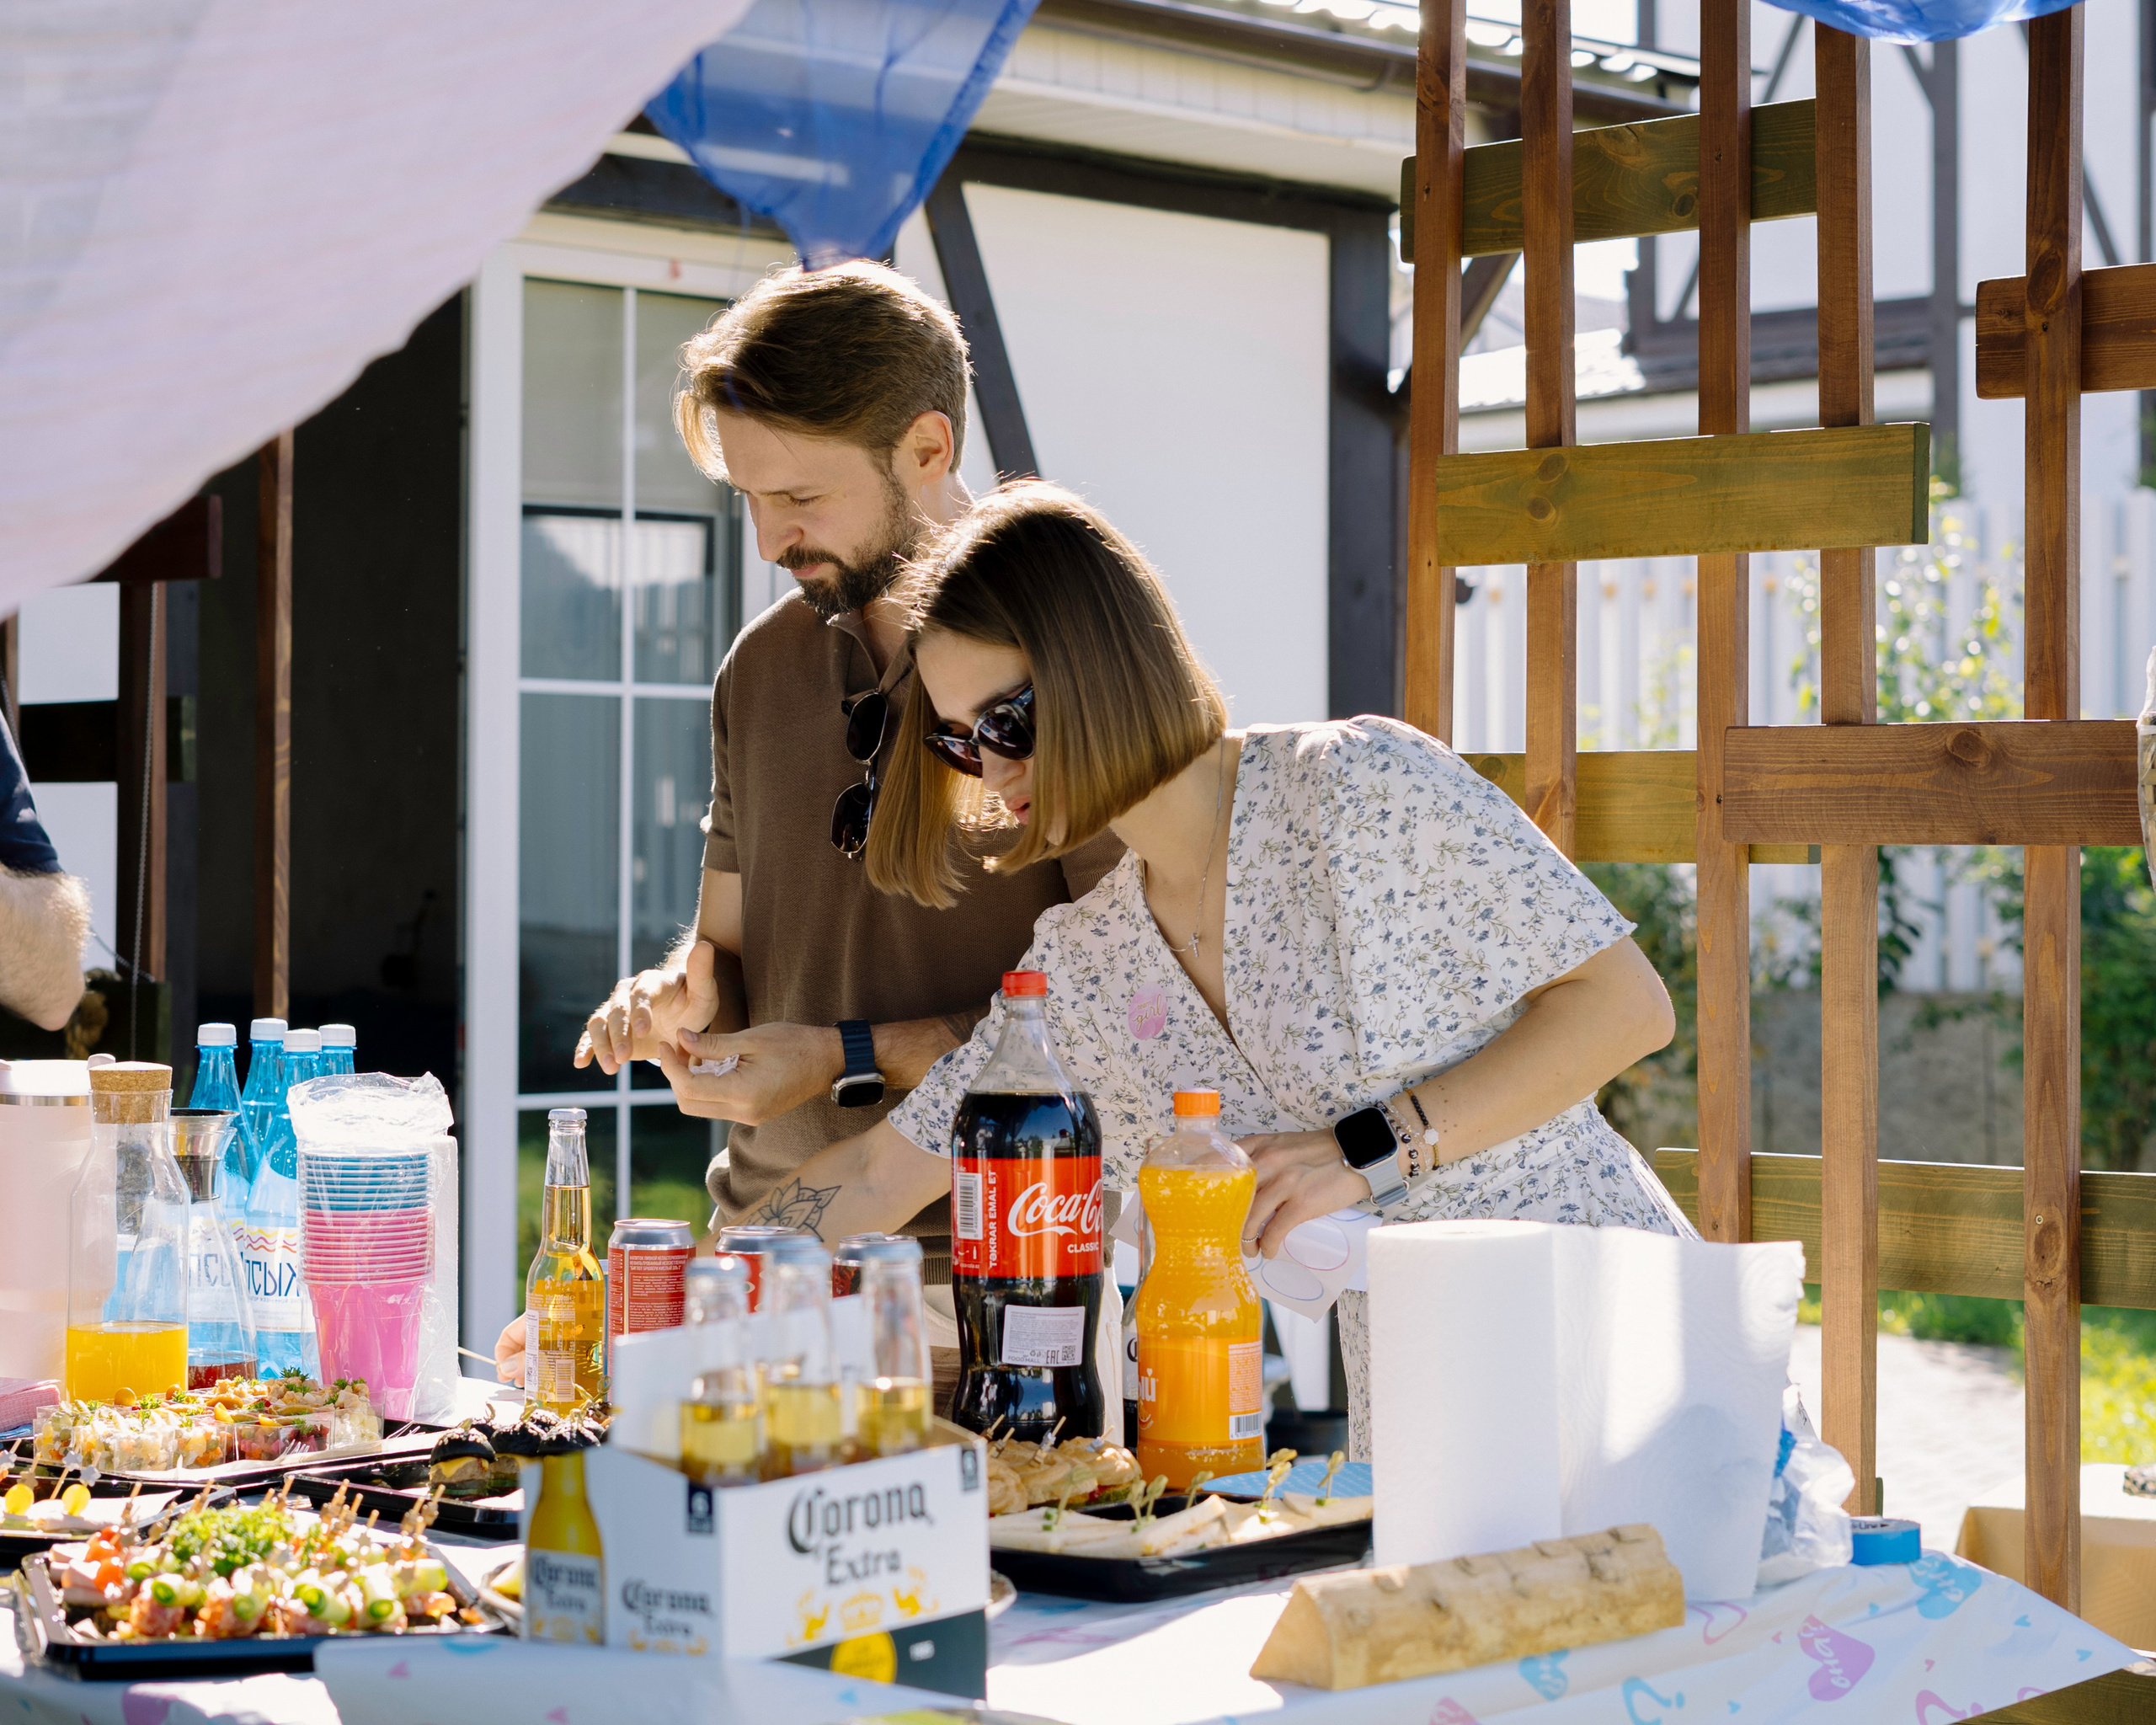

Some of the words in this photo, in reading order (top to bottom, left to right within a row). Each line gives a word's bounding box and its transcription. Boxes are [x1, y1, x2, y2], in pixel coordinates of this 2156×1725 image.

[1133, 994, 1164, 1032] girl
[988, 1170, 996, 1184] ET
[989, 1187, 997, 1219] EMAL
[1007, 1178, 1102, 1237] Coca-Co
[1067, 1242, 1099, 1253] CLASSIC
[1046, 1349, 1060, 1365] EAC
[789, 1482, 935, 1556] Corona
[826, 1545, 900, 1585] Extra
